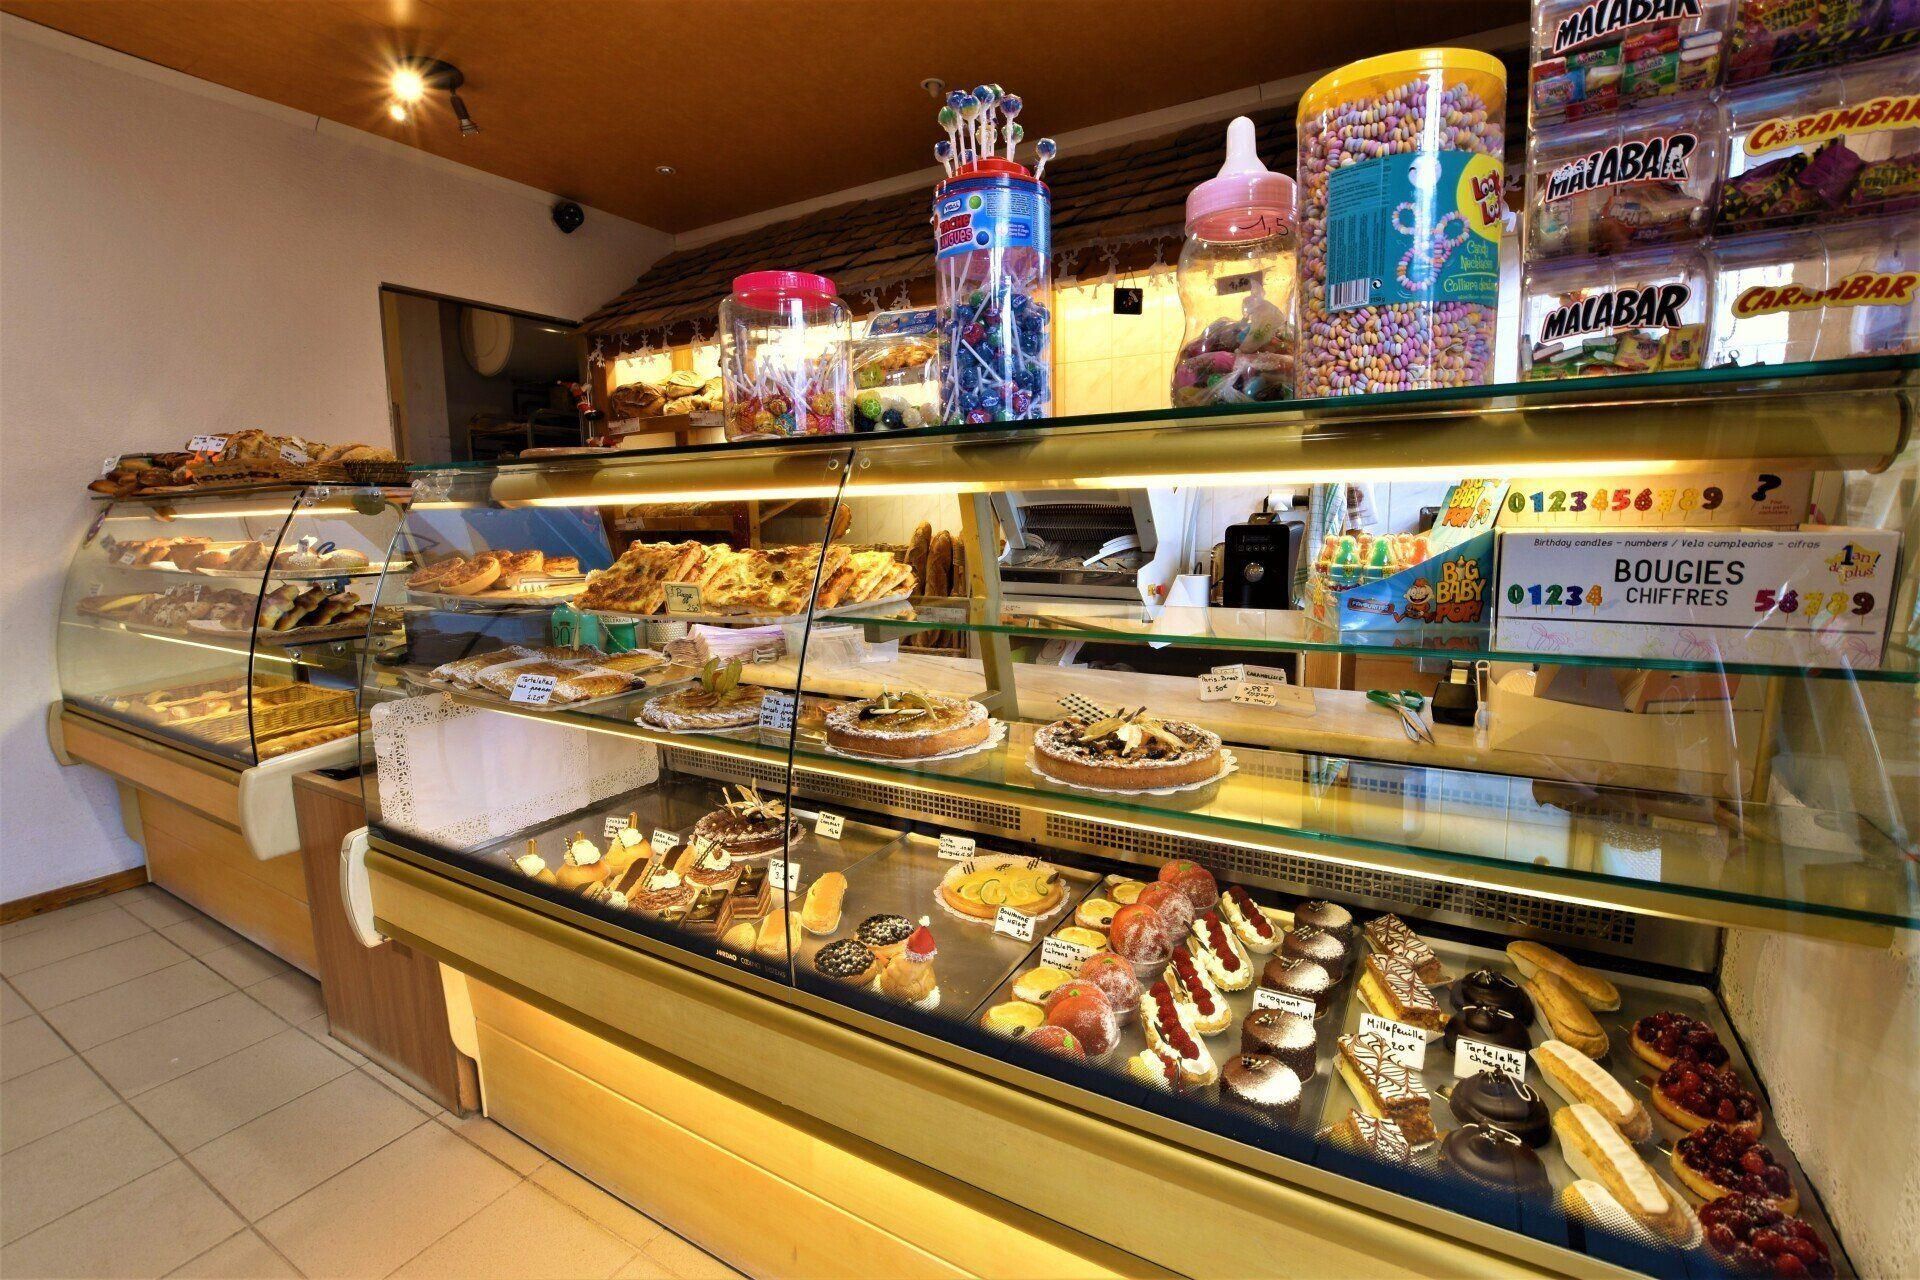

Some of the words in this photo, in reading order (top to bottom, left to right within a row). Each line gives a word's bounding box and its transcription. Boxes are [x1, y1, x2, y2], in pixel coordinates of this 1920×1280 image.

[1548, 135, 1697, 200] MALABAR
[1737, 275, 1917, 313] CARAMBAR
[1543, 284, 1689, 340] MALABAR
[1448, 487, 1486, 509] BABY
[1533, 538, 1572, 549] Birthday
[1574, 538, 1614, 547] candles
[1624, 539, 1669, 548] numbers
[1681, 538, 1705, 548] Vela
[1787, 539, 1821, 549] cifras
[1441, 557, 1480, 582] BIG
[1614, 557, 1746, 587] BOUGIES
[1435, 578, 1487, 604] BABY
[1625, 586, 1729, 607] CHIFFRES
[1434, 600, 1486, 623] POP!
